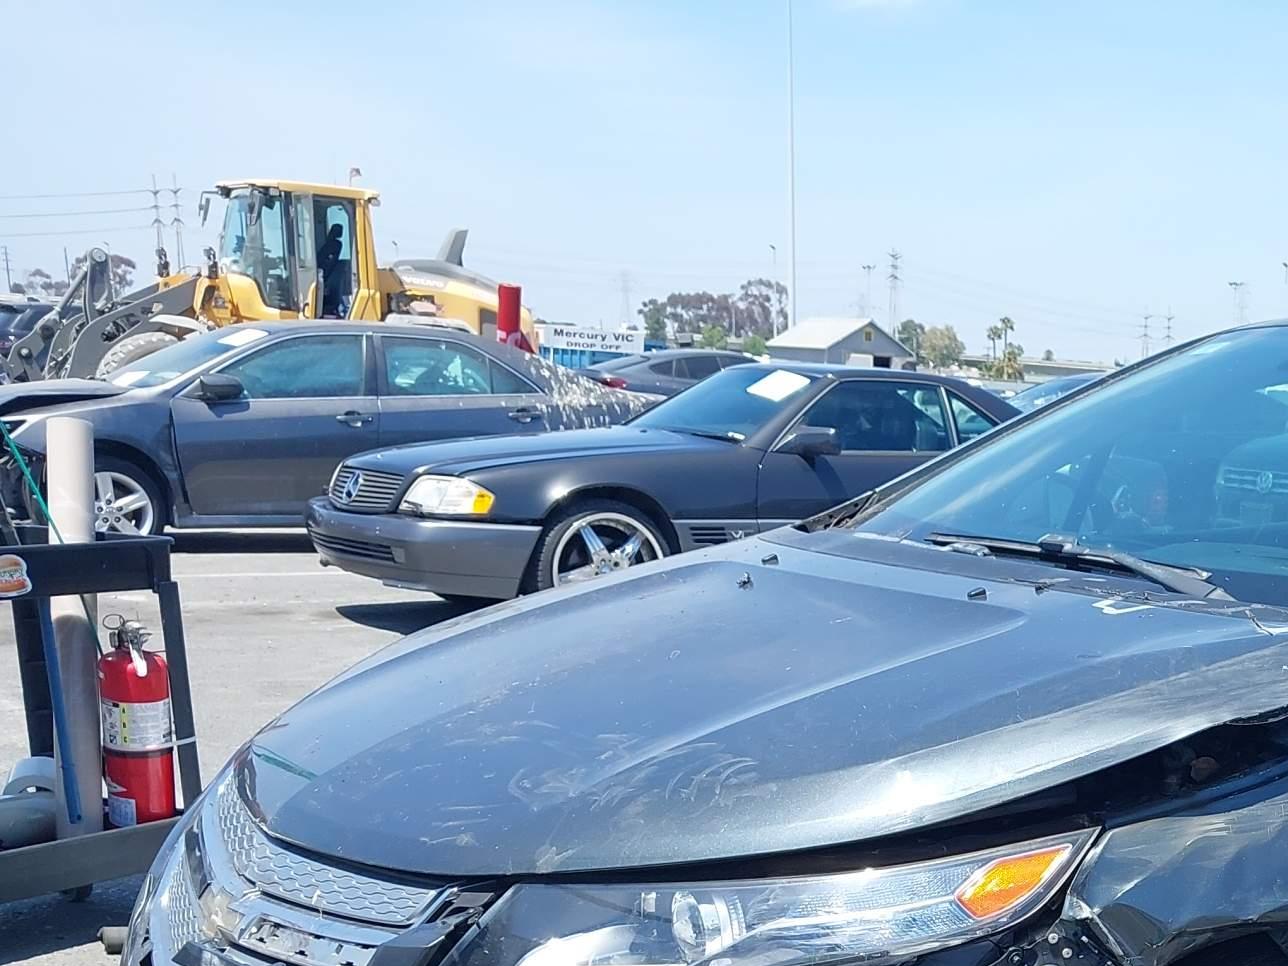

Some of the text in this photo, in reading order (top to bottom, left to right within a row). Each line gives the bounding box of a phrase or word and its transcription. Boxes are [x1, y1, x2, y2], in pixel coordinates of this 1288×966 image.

[554, 328, 635, 343] Mercury VIC
[566, 340, 622, 350] DROP OFF
